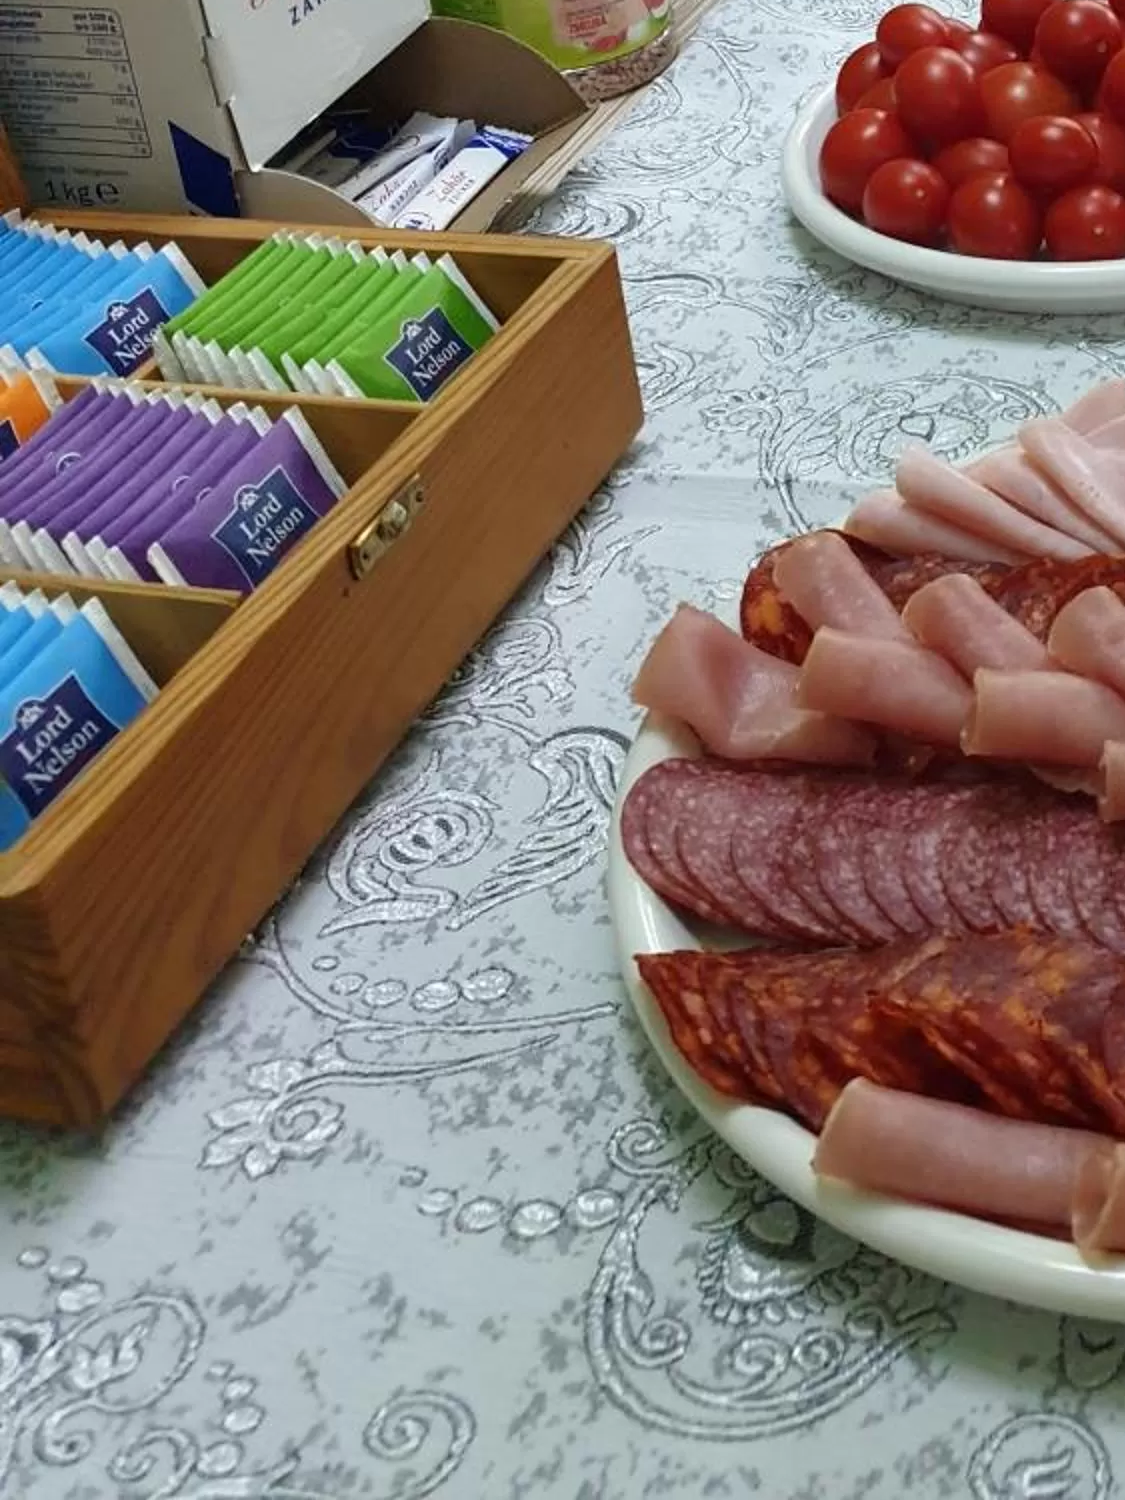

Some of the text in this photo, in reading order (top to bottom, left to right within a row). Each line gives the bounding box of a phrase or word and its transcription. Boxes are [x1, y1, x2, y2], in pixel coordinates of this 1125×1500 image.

[107, 307, 150, 346] Lord
[404, 325, 443, 366] Lord
[412, 341, 462, 387] Nelson
[239, 492, 283, 542] Lord
[246, 507, 305, 567] Nelson
[15, 704, 73, 766] Lord
[23, 720, 100, 795] Nelson
